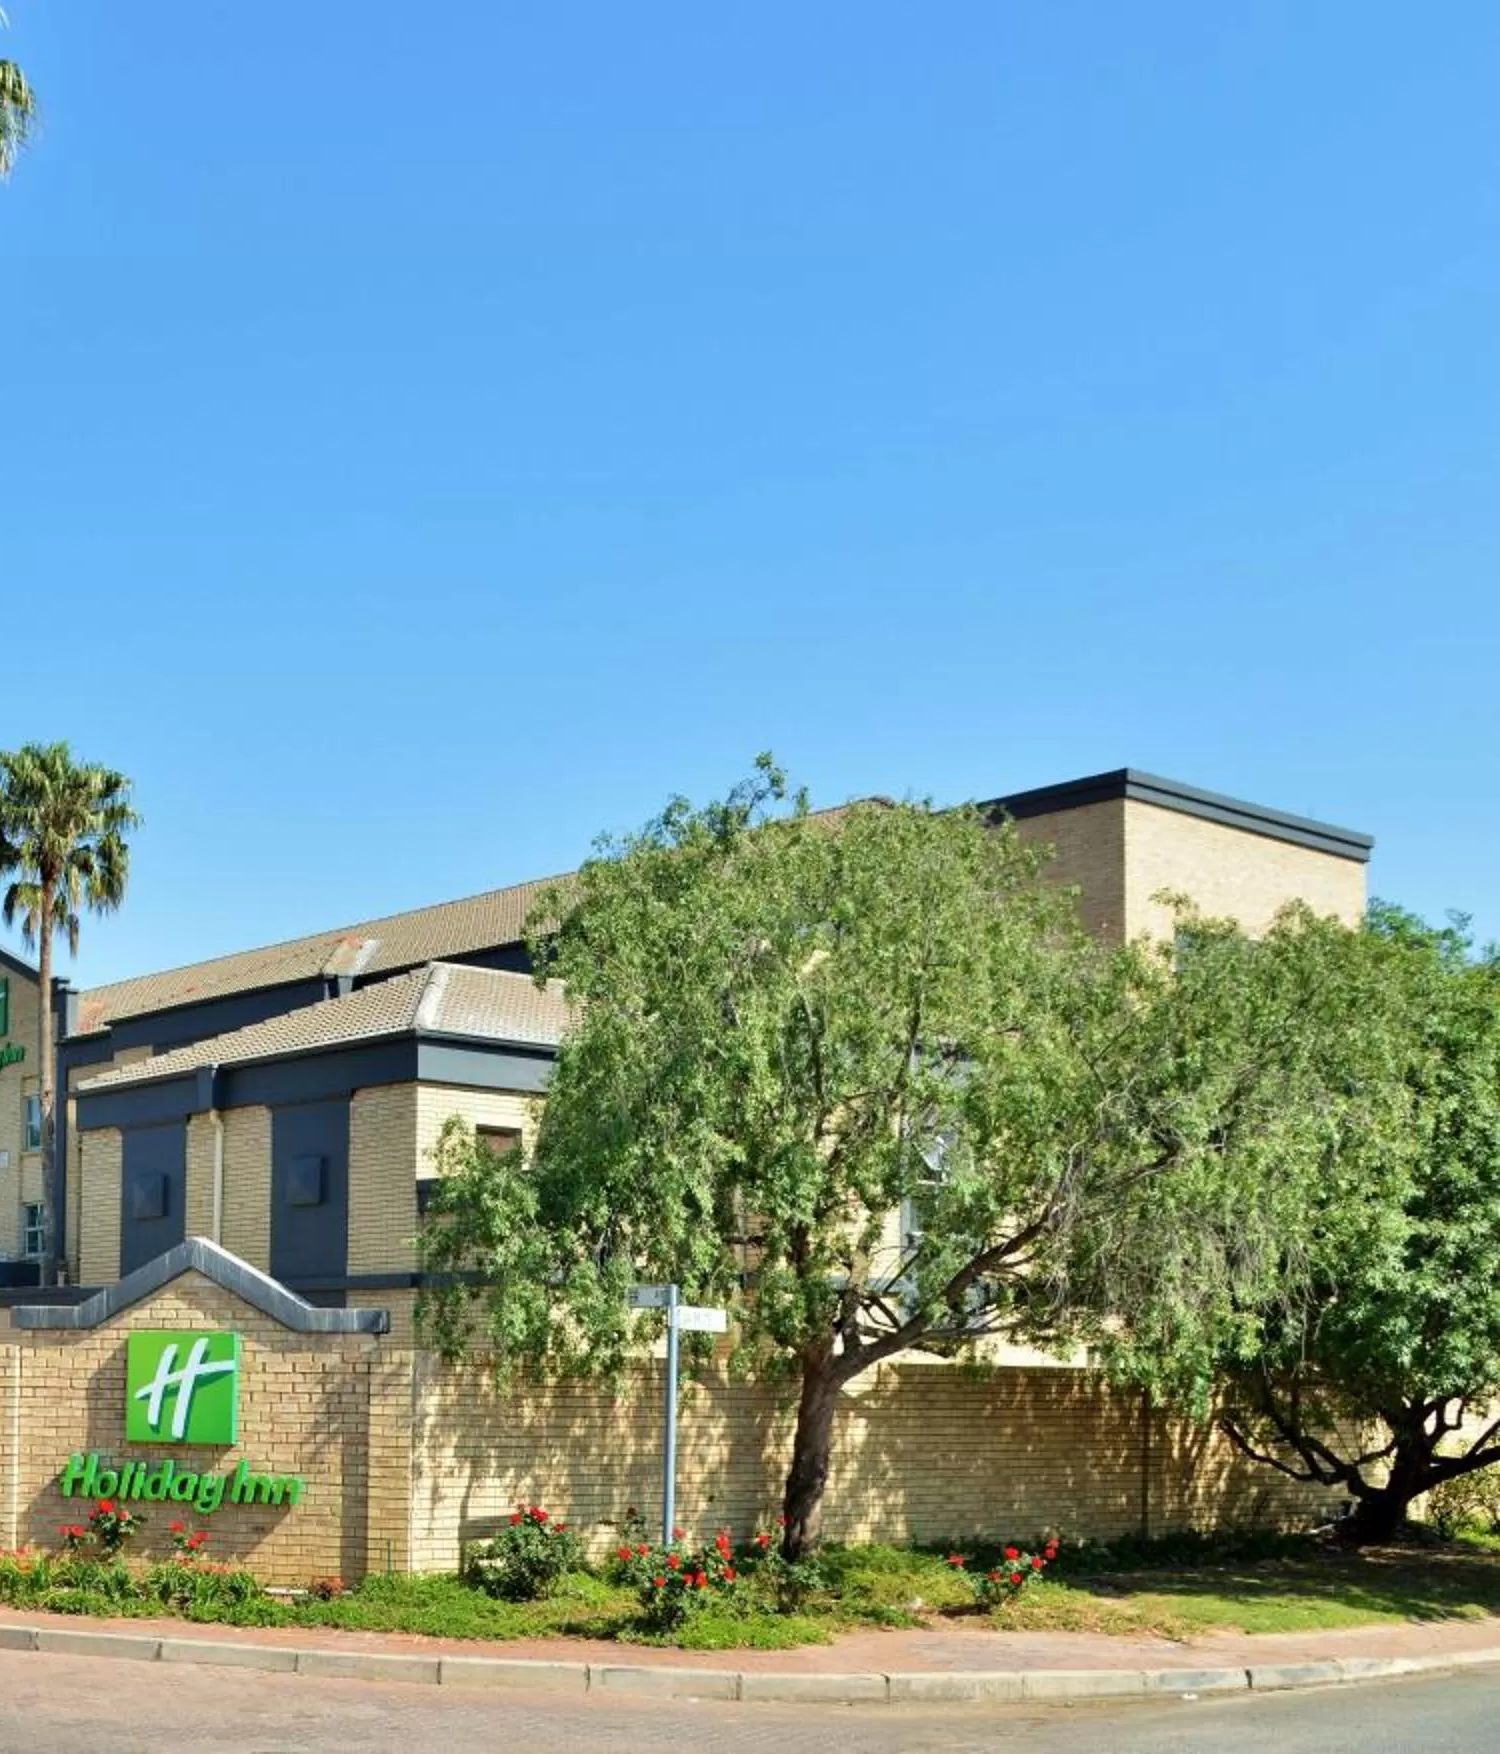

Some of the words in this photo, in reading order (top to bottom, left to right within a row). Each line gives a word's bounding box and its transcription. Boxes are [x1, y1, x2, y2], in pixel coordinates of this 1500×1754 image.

[134, 1337, 236, 1440] H
[60, 1451, 228, 1515] Holiday
[231, 1457, 307, 1505] Inn
